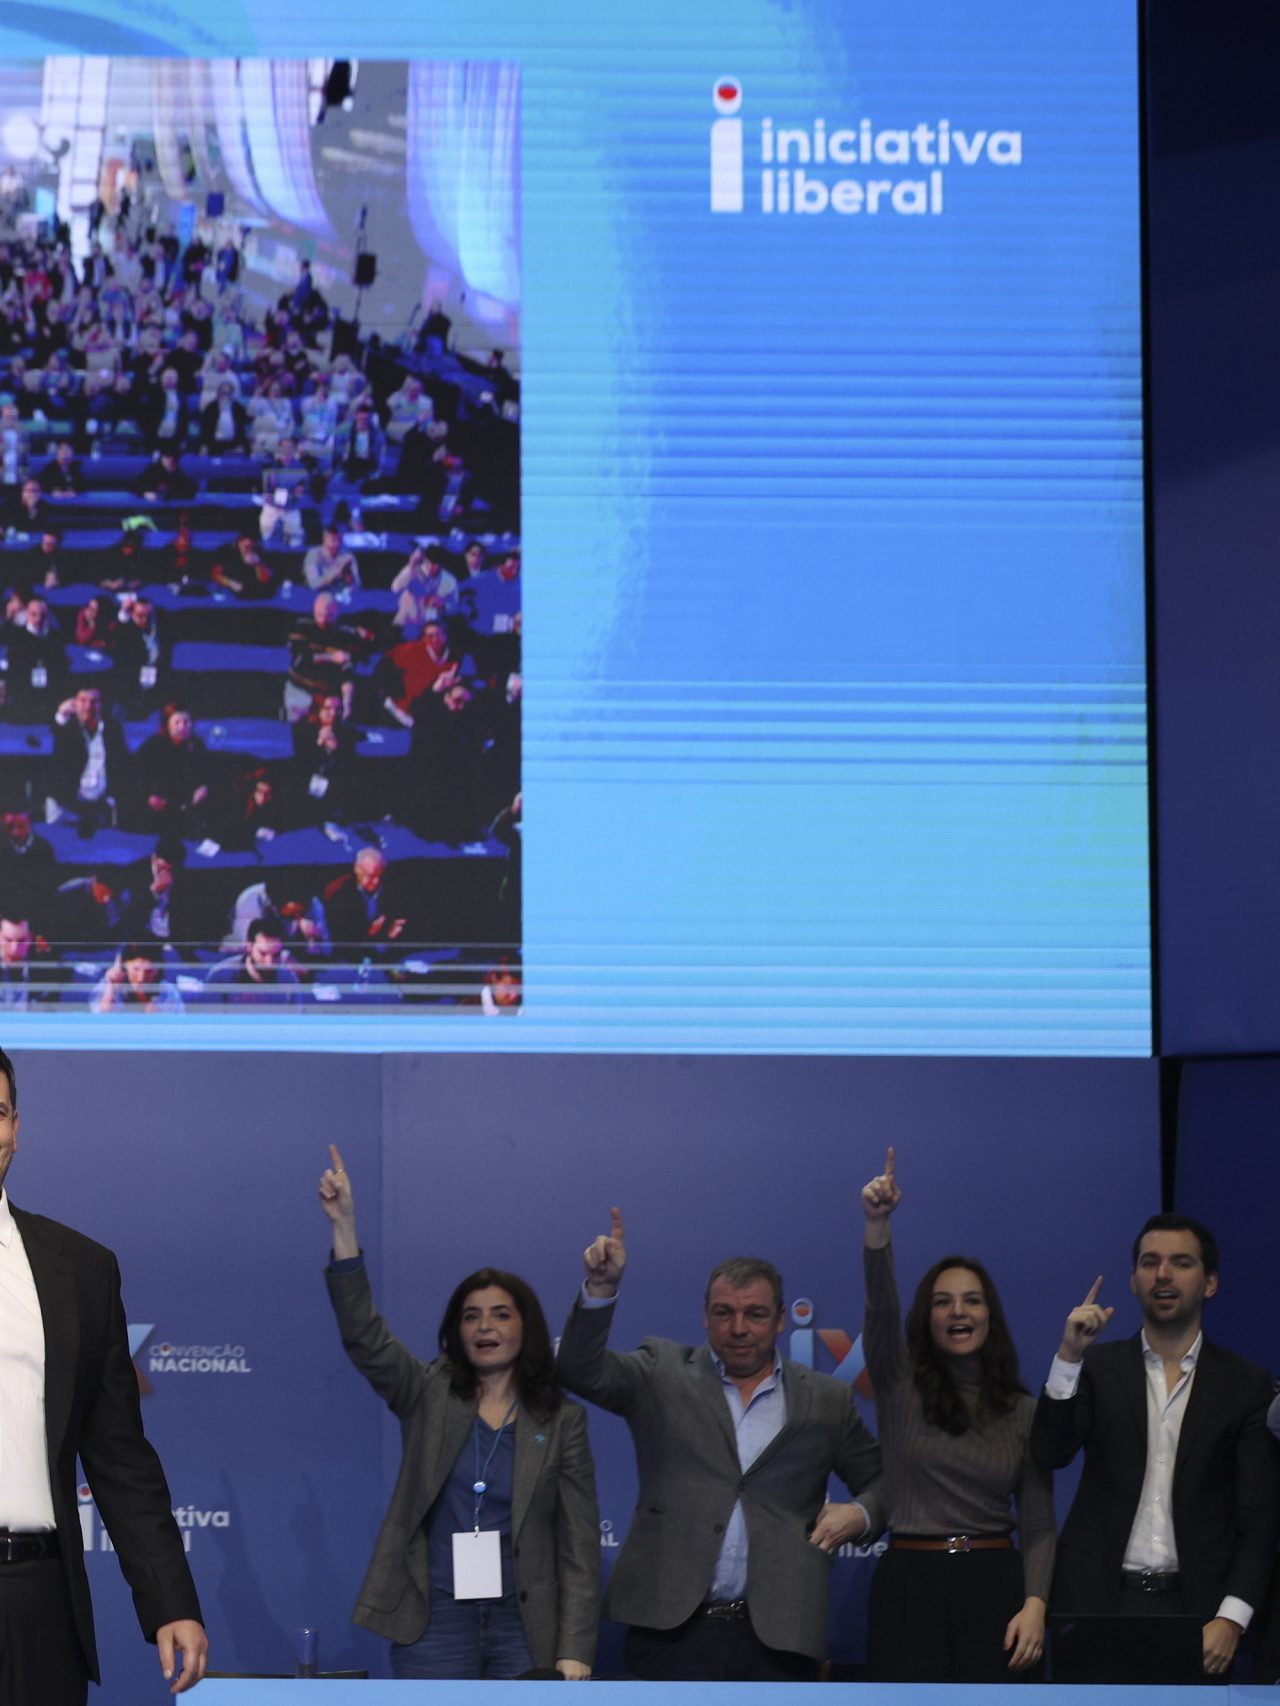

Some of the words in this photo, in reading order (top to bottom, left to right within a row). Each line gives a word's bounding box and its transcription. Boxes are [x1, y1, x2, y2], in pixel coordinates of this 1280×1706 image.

[761, 118, 1022, 165] iniciativa
[761, 169, 943, 214] liberal
[149, 1358, 252, 1373] NACIONAL
